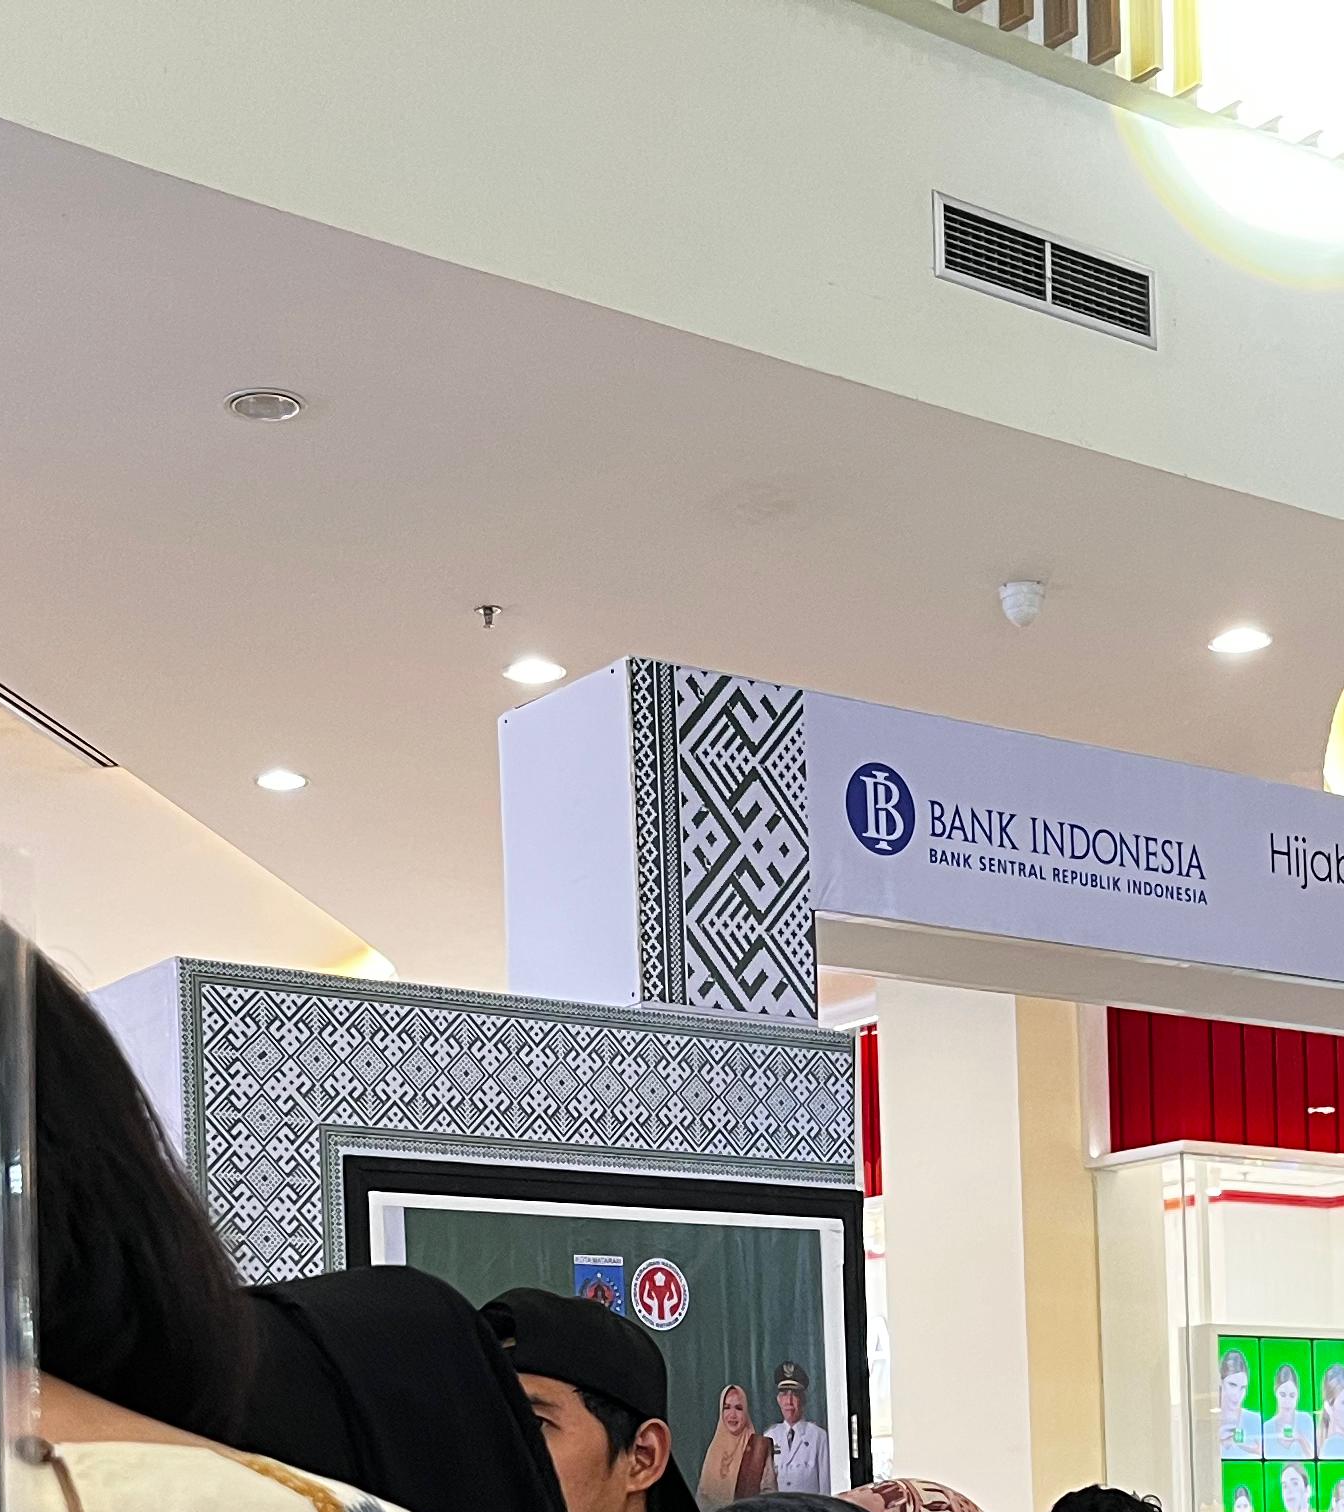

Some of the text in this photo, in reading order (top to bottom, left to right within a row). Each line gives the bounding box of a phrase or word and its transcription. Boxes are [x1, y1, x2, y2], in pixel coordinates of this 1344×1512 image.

[927, 799, 1207, 881] BANK INDONESIA
[928, 848, 1209, 906] BANK SENTRAL REPUBLIK INDONESIA
